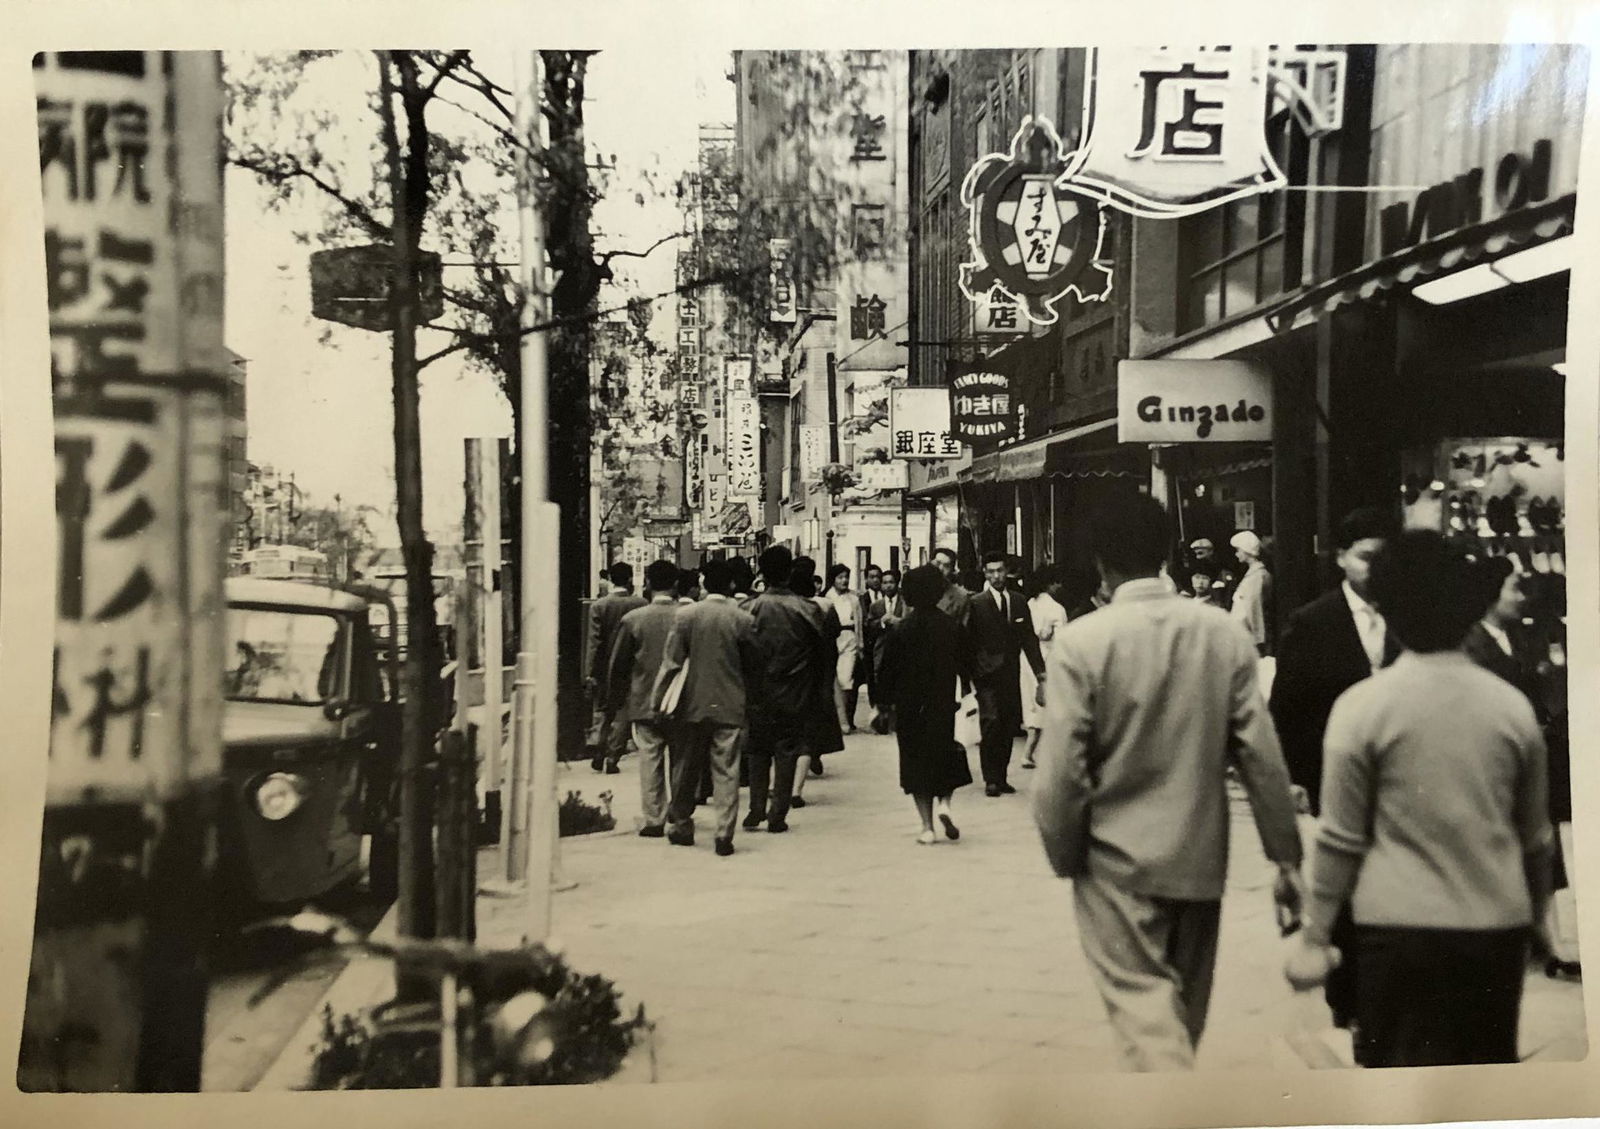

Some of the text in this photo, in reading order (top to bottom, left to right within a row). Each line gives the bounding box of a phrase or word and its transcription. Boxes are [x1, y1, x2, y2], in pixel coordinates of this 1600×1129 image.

[1125, 45, 1229, 160] 店
[954, 393, 1010, 416] ゆき屋
[1137, 395, 1265, 439] Ginzado
[959, 421, 1006, 436] YUKIYA
[895, 430, 959, 455] 銀座堂
